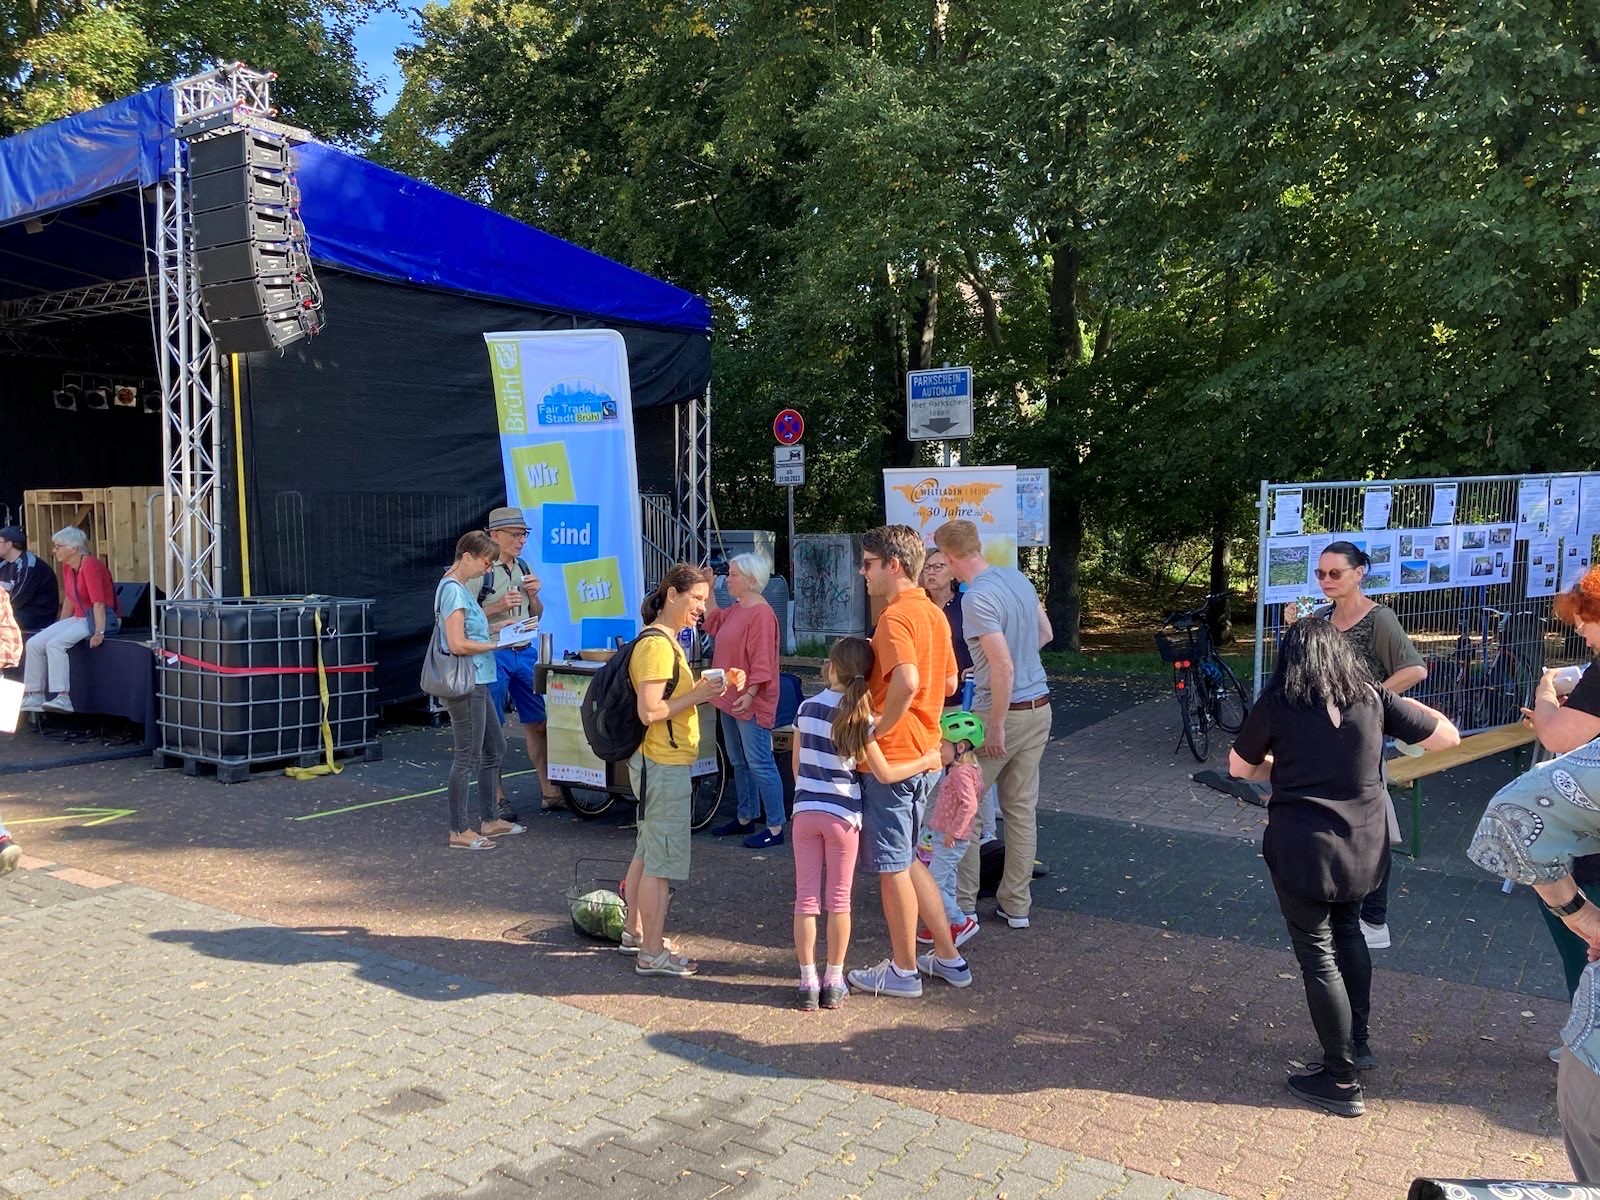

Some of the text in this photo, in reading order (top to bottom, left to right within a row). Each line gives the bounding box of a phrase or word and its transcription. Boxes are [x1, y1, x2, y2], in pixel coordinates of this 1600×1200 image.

[913, 373, 966, 387] PARKSCHEIN-
[921, 385, 957, 398] AUTOMAT
[500, 373, 525, 431] Brühl
[539, 403, 592, 414] Fair Trade
[911, 399, 969, 409] Hier Parkschein
[545, 413, 574, 424] Stadt
[576, 412, 600, 422] Brühl
[524, 462, 560, 489] Wir
[920, 488, 962, 496] WELTLADEN
[927, 506, 940, 517] 30
[942, 506, 973, 518] Jahre
[551, 521, 591, 545] sind
[577, 576, 612, 603] fair
